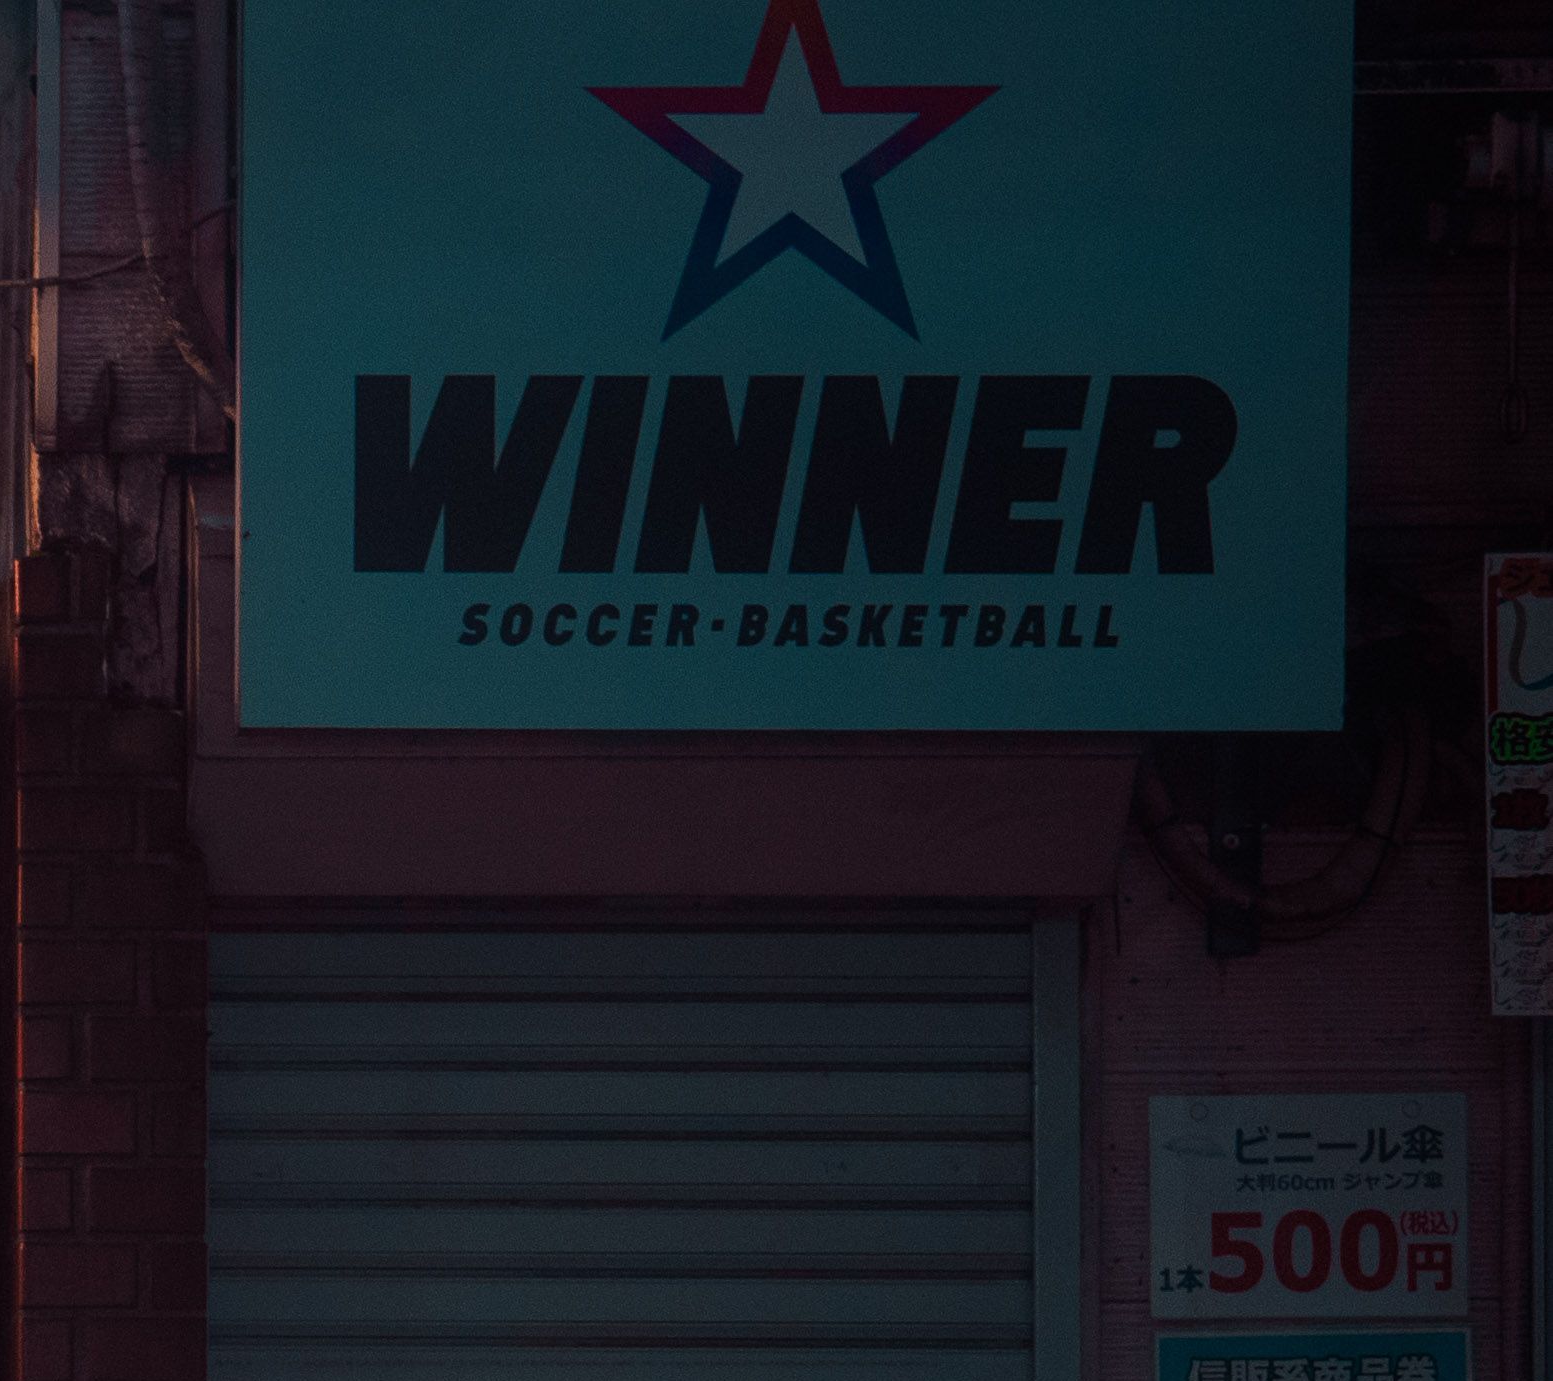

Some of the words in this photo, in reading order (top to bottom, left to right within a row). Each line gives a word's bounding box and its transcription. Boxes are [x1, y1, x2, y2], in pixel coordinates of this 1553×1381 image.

[353, 373, 1239, 576] WINNER
[1234, 1123, 1445, 1165] ビニール傘
[1236, 1173, 1336, 1193] 大判60cm
[1342, 1172, 1444, 1191] ジャンプ傘
[1399, 1208, 1459, 1238] (税込)
